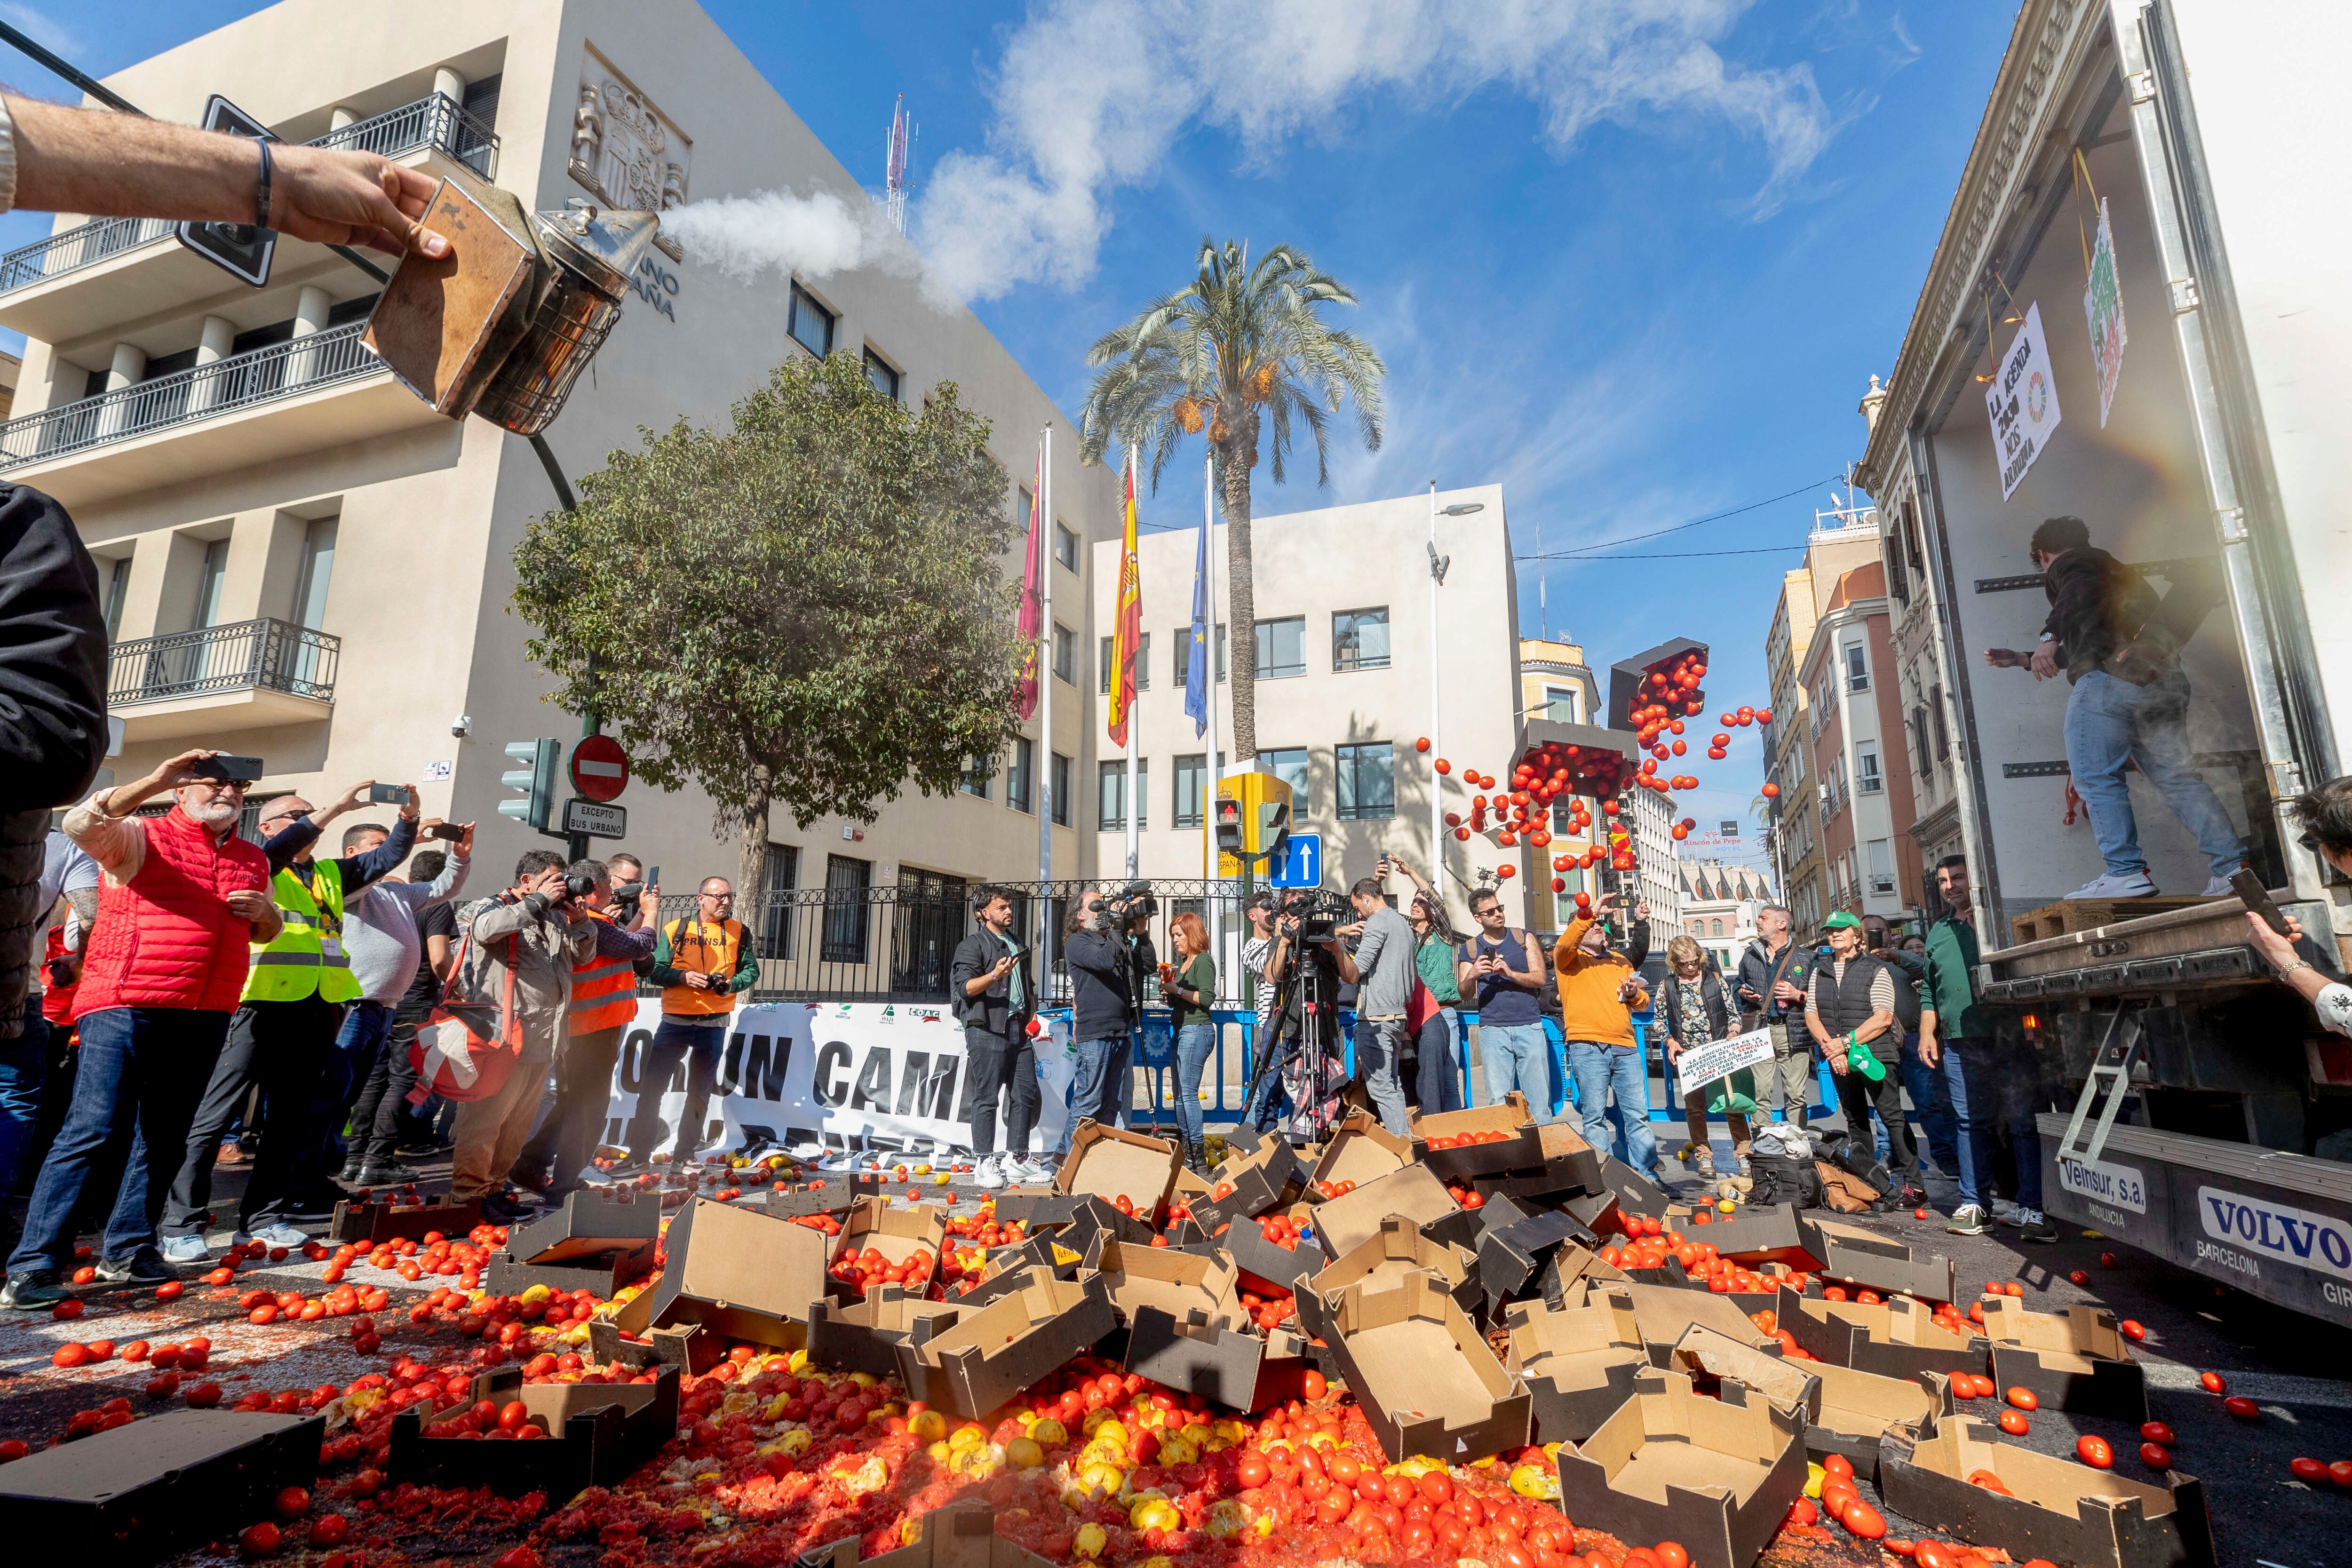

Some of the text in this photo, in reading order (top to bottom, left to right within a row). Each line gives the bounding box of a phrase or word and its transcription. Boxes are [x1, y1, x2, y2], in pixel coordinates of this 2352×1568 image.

[1990, 337, 2031, 421] LA AGENDA
[2005, 423, 2021, 460] NOS
[2004, 437, 2035, 492] ARRUINA
[581, 806, 614, 819] EXCEPTO
[571, 819, 621, 834] BUS URBANO
[1218, 858, 1241, 870] SPAÑA
[909, 1008, 940, 1017] COAG
[1696, 1055, 1726, 1071] ADECUADA
[1738, 1041, 1769, 1053] SENCILLO
[1699, 1043, 1739, 1060] AGRICULTURA
[1698, 1054, 1752, 1079] DIGNA PARA TODO
[1692, 1073, 1716, 1087] HOMBRE
[2119, 1178, 2145, 1206] s.a.
[2089, 1202, 2126, 1228] ANDALUCIA
[2207, 1196, 2352, 1269] VOLVO
[2197, 1240, 2260, 1279] BARCELONA
